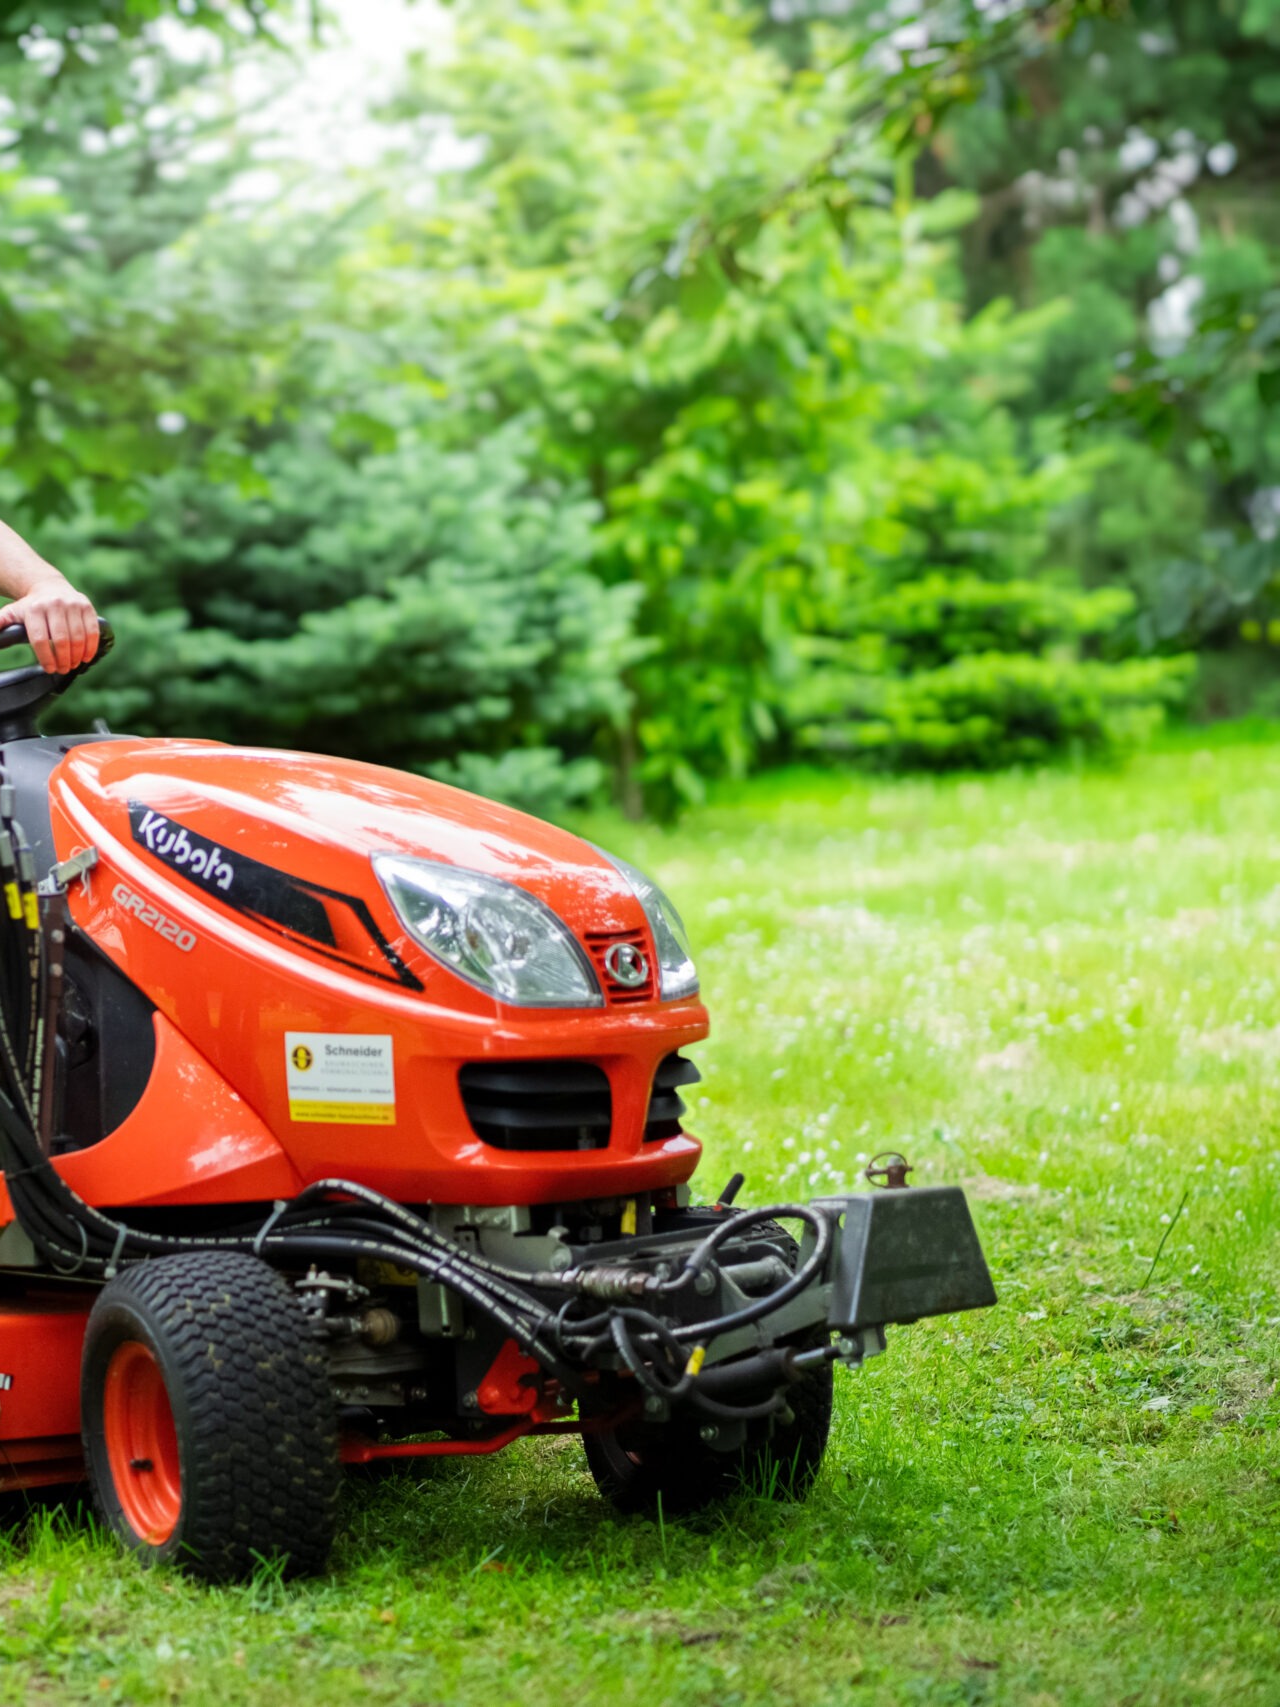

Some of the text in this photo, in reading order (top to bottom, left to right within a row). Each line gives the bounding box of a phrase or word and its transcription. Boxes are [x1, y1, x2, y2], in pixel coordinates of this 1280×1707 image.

[138, 810, 234, 890] Kubota
[112, 883, 196, 952] GR2120
[324, 1044, 383, 1057] Schneider
